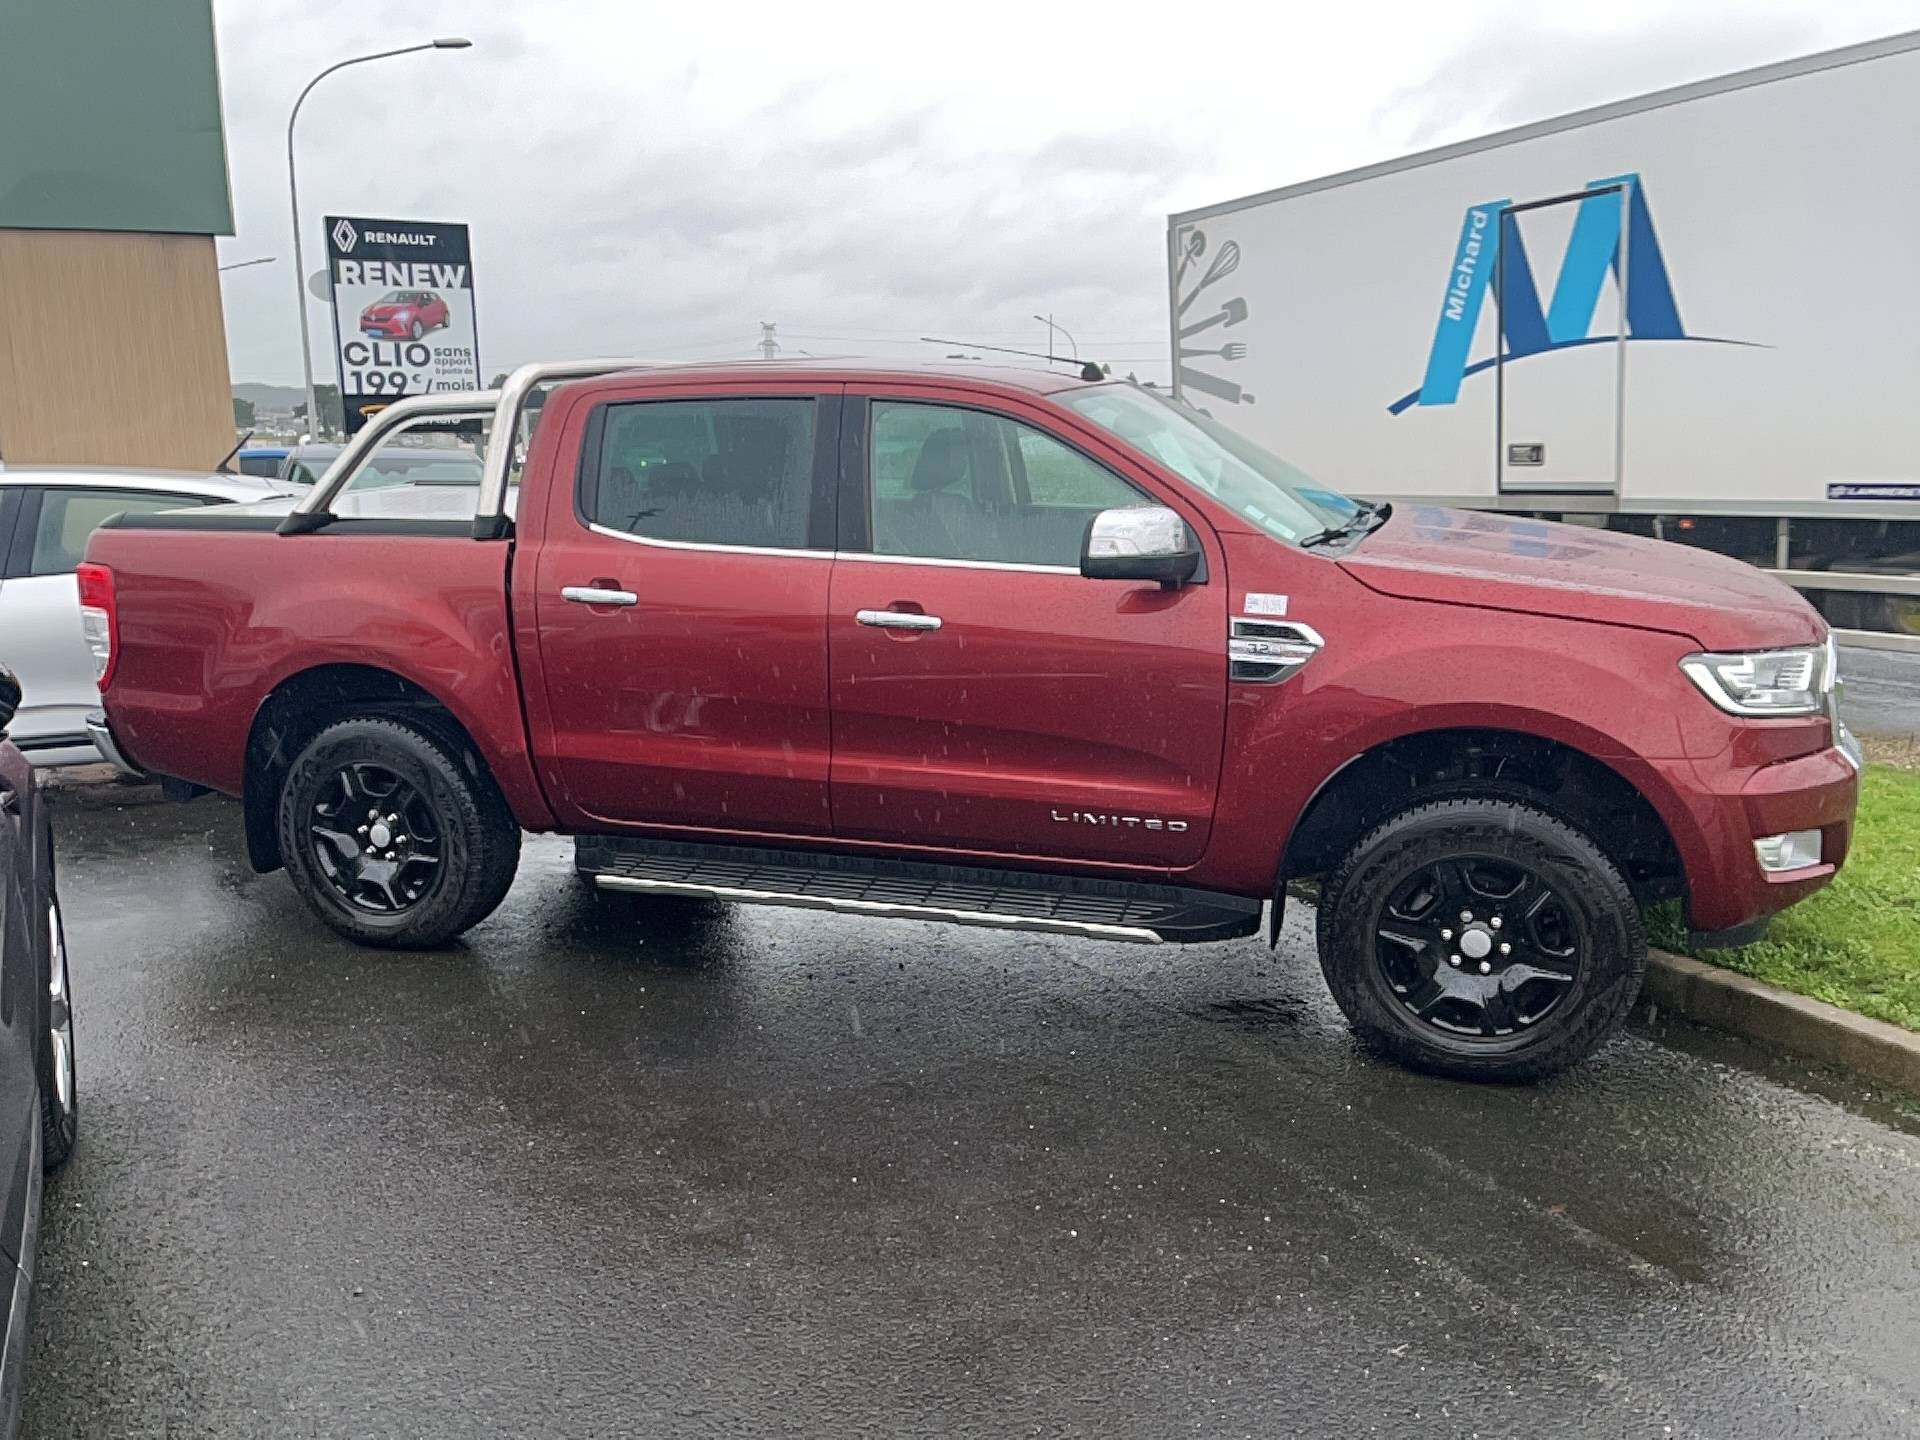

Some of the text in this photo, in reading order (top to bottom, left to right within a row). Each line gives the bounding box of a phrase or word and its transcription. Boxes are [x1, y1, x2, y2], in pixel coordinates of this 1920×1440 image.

[364, 231, 436, 246] RENAULT
[338, 259, 466, 288] RENEW
[1445, 210, 1489, 321] Michard
[343, 342, 431, 367] CLIO
[434, 347, 471, 357] sans
[434, 356, 472, 367] apport
[1051, 809, 1188, 831] LIMITED
